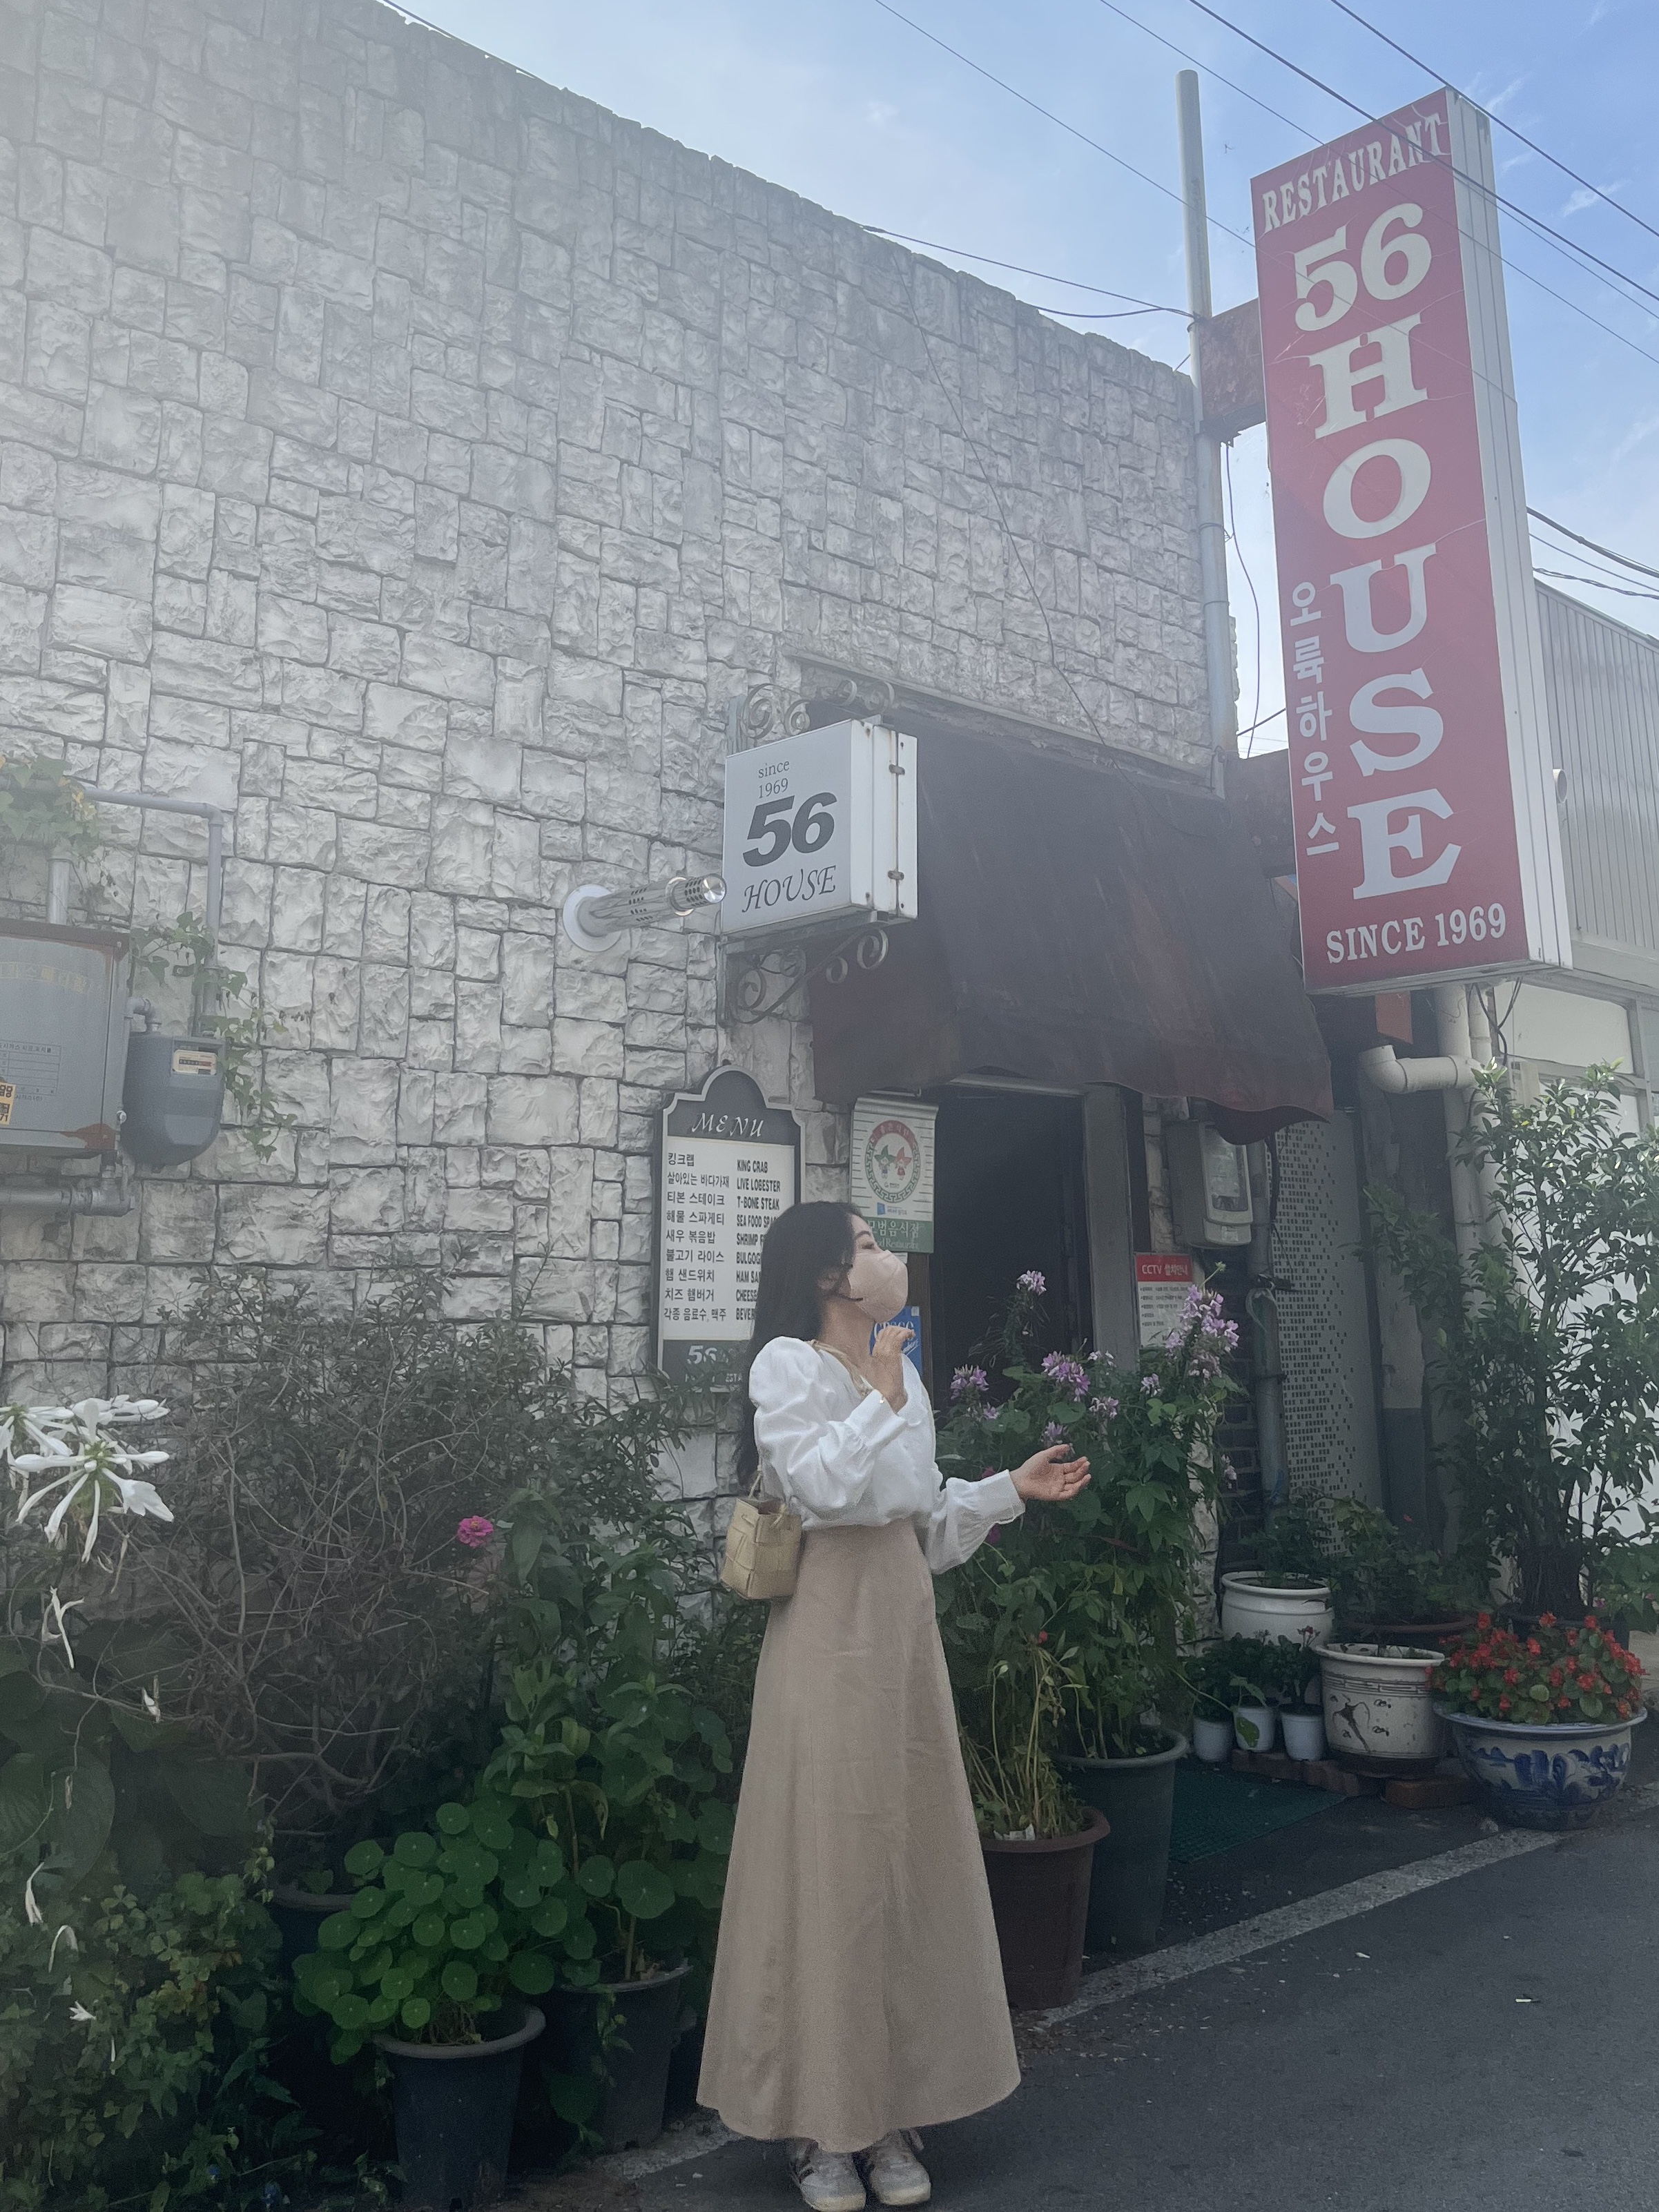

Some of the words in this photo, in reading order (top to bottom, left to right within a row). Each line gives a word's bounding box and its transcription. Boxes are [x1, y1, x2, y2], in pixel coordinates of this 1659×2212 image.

[1262, 113, 1444, 233] RESTAURANT
[1293, 203, 1432, 332] 56
[1309, 312, 1462, 900] HOUSE
[1289, 581, 1339, 856] 오륙하우스
[758, 761, 790, 778] since
[759, 777, 789, 799] 1969
[742, 792, 837, 867] 56
[741, 865, 837, 913] HOUSE
[1327, 916, 1426, 964] SINCE
[1435, 902, 1507, 948] 1969
[691, 1112, 764, 1137] MENU
[668, 1152, 695, 1167] 킹크랩
[737, 1158, 751, 1172] KING
[753, 1160, 768, 1174] CRAB
[667, 1172, 697, 1186] 살아있는
[700, 1174, 730, 1188] 바다가재
[737, 1177, 750, 1190] LIVE
[667, 1191, 686, 1204] 티본
[689, 1192, 725, 1205] 스테이크
[737, 1195, 759, 1210] T-BONE
[760, 1196, 780, 1211] STEAK
[666, 1210, 685, 1223] 해물
[689, 1211, 725, 1225] 스파게티
[737, 1214, 746, 1227] SEA
[748, 1215, 762, 1228] FOOD
[666, 1229, 685, 1243] 새우
[688, 1230, 716, 1244] 볶음밥
[867, 1219, 920, 1239] 모범음식점
[736, 1232, 759, 1246] SHRIMP
[666, 1248, 693, 1262] 불고기
[697, 1250, 724, 1263] 라이스
[736, 1251, 761, 1265] BULGOG
[665, 1268, 674, 1281] 햄
[678, 1268, 715, 1283] 샌드위치
[736, 1270, 749, 1283] HAM
[1141, 1264, 1162, 1274] CCTV
[664, 1288, 683, 1301] 치즈
[687, 1288, 715, 1301] 햄버거
[663, 1308, 680, 1321] 각종
[711, 1308, 726, 1321] 맥주
